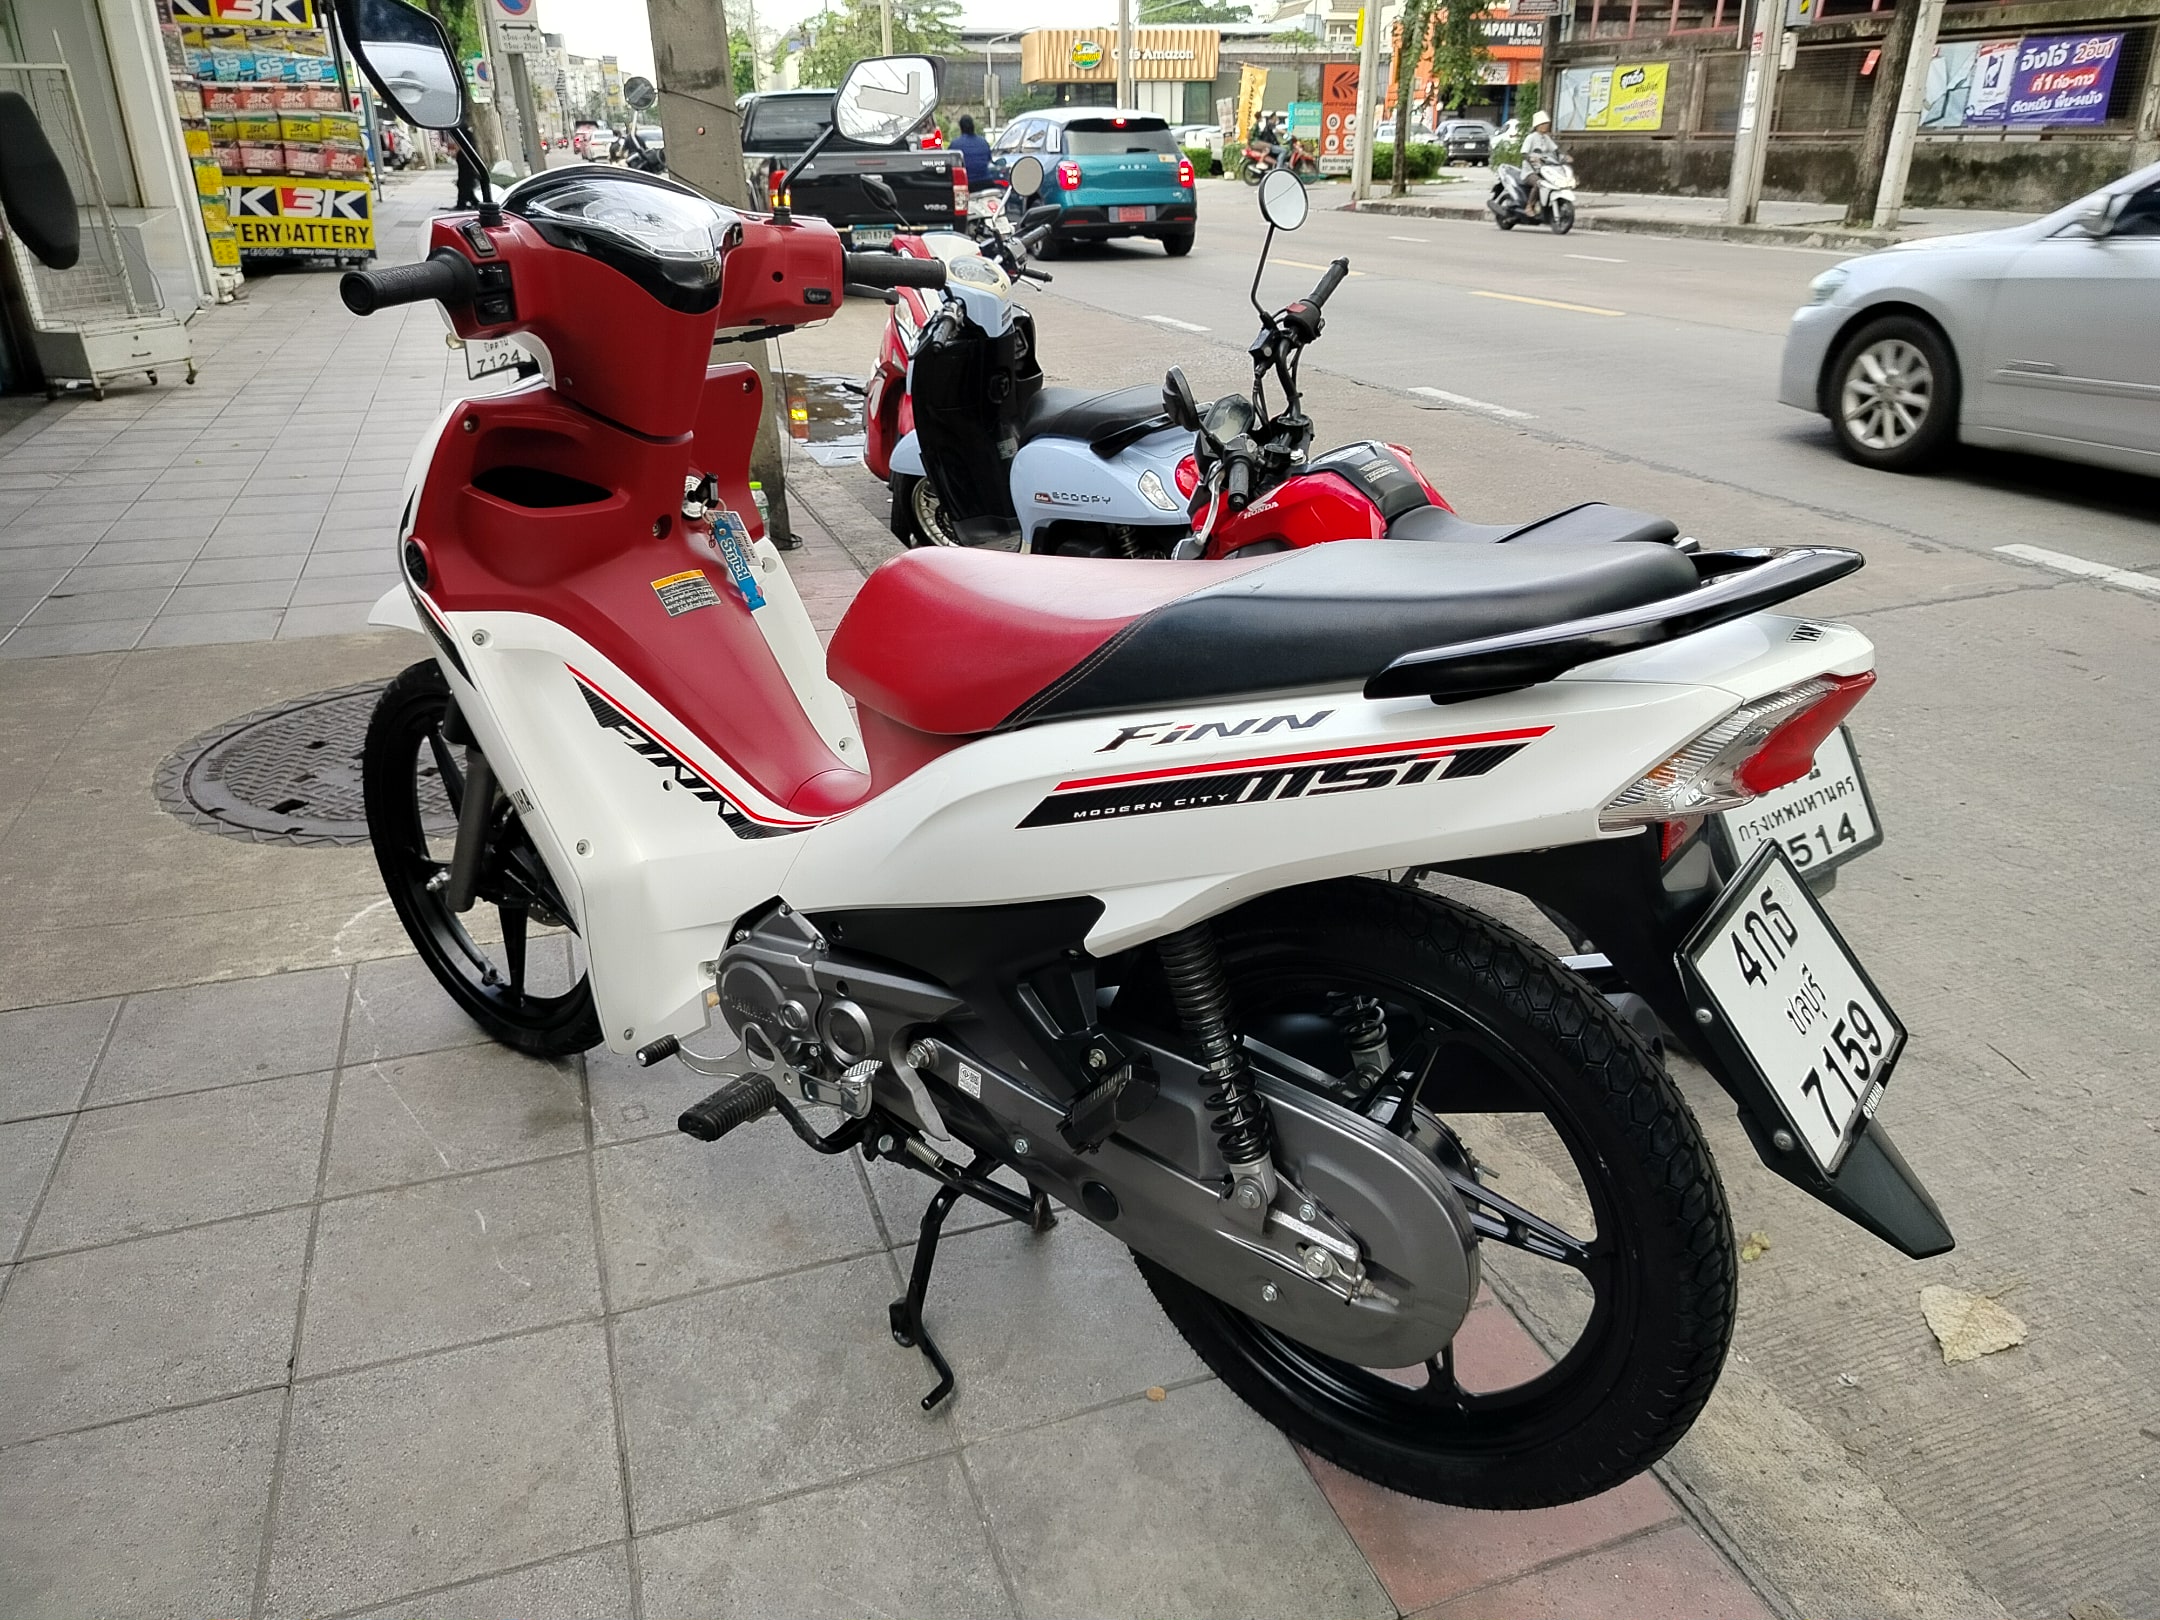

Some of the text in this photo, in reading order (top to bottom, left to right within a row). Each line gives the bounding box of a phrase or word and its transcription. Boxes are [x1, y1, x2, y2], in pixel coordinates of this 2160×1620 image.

[1517, 22, 1542, 36] No.1
[214, 57, 241, 70] GS
[1141, 47, 1195, 60] Amazon
[256, 58, 283, 73] GS
[296, 61, 322, 76] GS
[282, 187, 368, 220] 3K
[477, 349, 520, 373] 7124
[1052, 491, 1111, 504] SCOOPY
[1243, 501, 1279, 519] HONDA
[1073, 801, 1162, 818] MODERN
[1174, 793, 1229, 807] CITY
[1738, 776, 1856, 841] กรุงเทพมหานคร
[1730, 885, 1799, 988] 4กธ
[1786, 963, 1830, 1036] ชลบุรี
[1799, 1000, 1883, 1138] 7159
